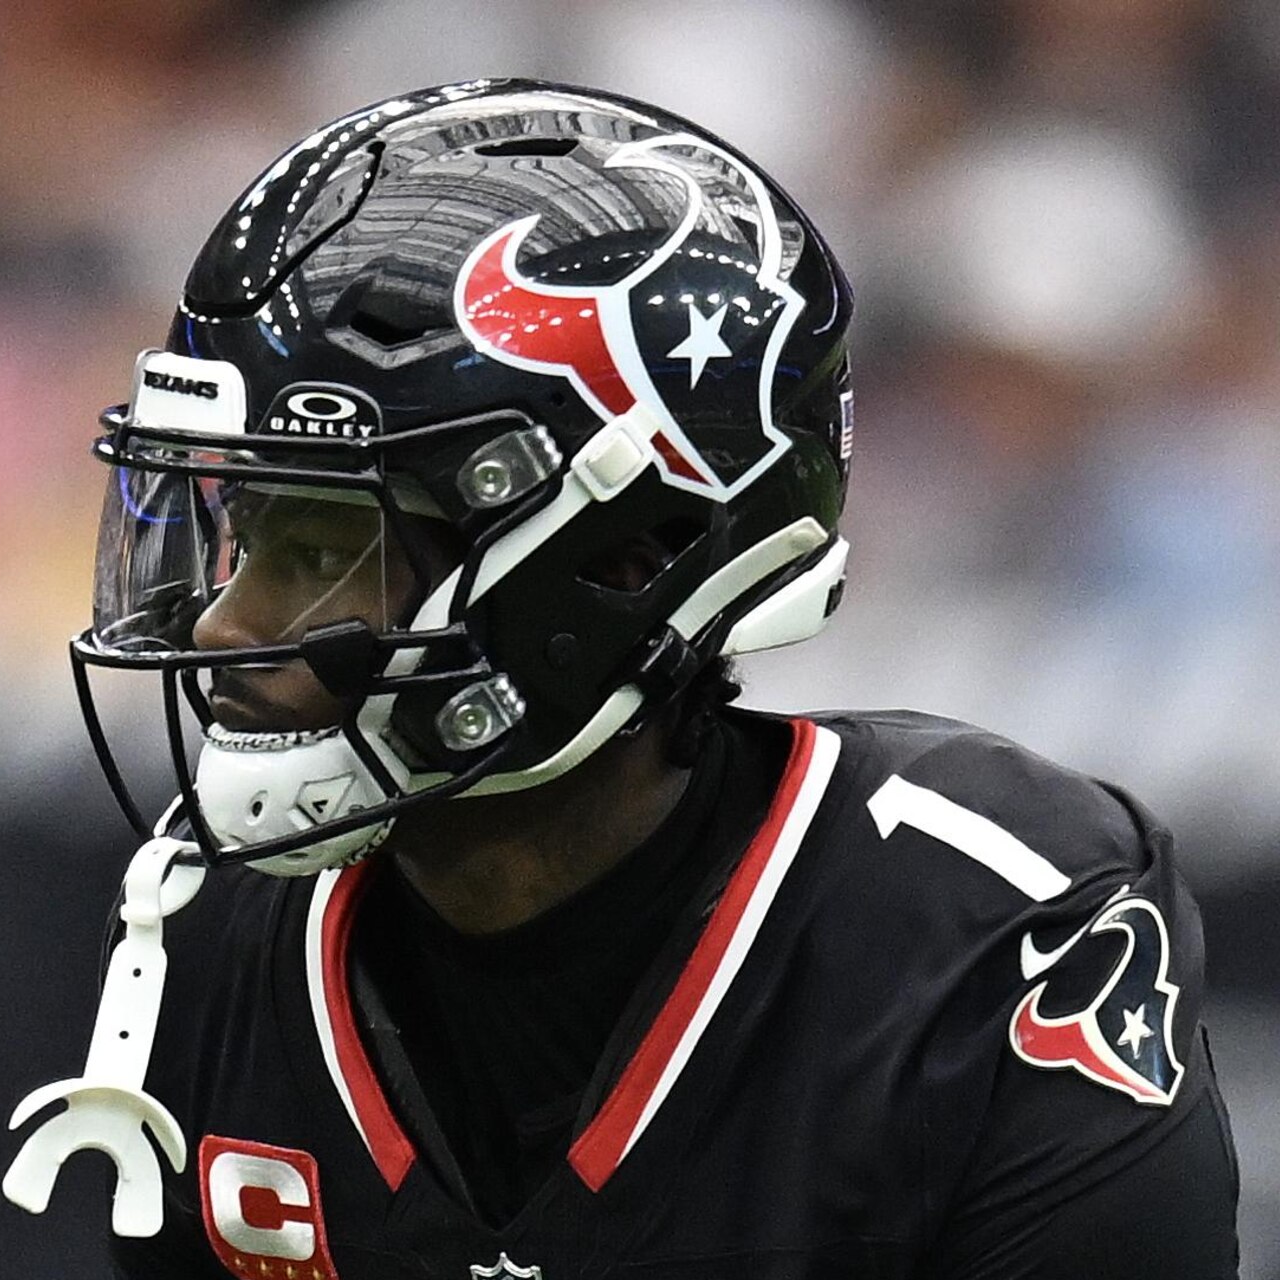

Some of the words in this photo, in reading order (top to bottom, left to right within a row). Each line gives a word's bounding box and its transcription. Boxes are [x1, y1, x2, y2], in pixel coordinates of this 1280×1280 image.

[270, 416, 374, 438] OAKLEY
[866, 773, 1071, 902] 1
[208, 1151, 316, 1262] C
